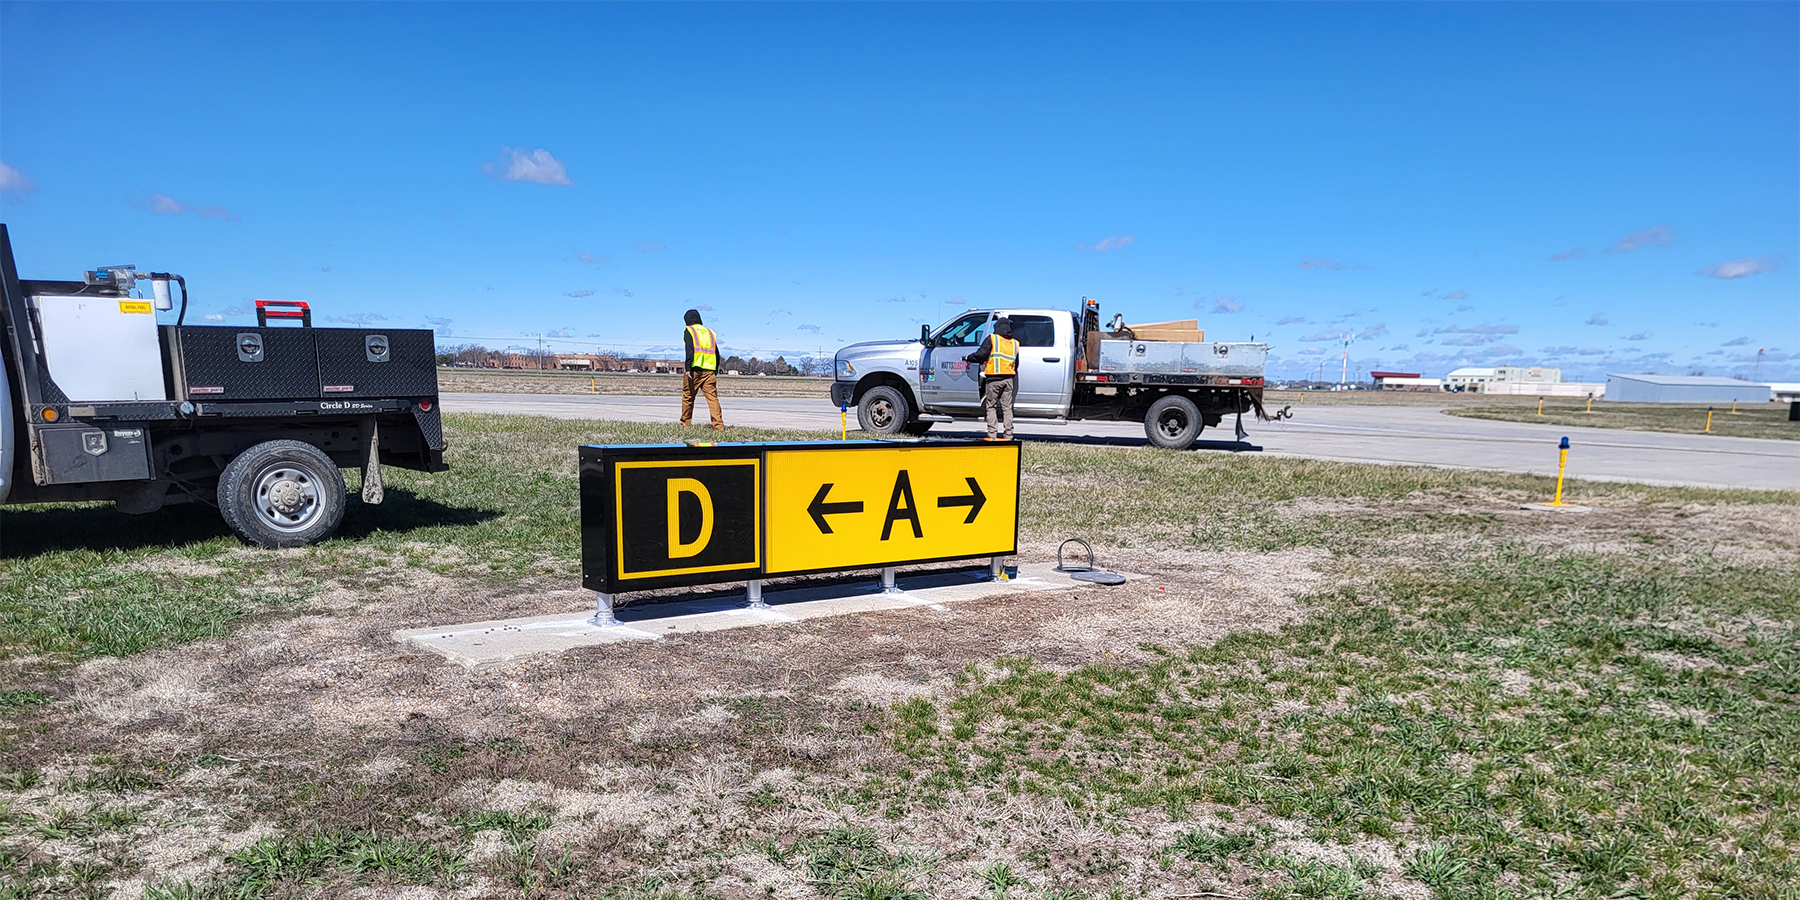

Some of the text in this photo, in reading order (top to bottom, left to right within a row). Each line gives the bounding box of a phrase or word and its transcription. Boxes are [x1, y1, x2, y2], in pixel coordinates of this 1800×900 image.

[320, 401, 342, 409] Circle
[344, 401, 350, 409] D
[666, 477, 715, 559] D
[880, 469, 924, 541] A
